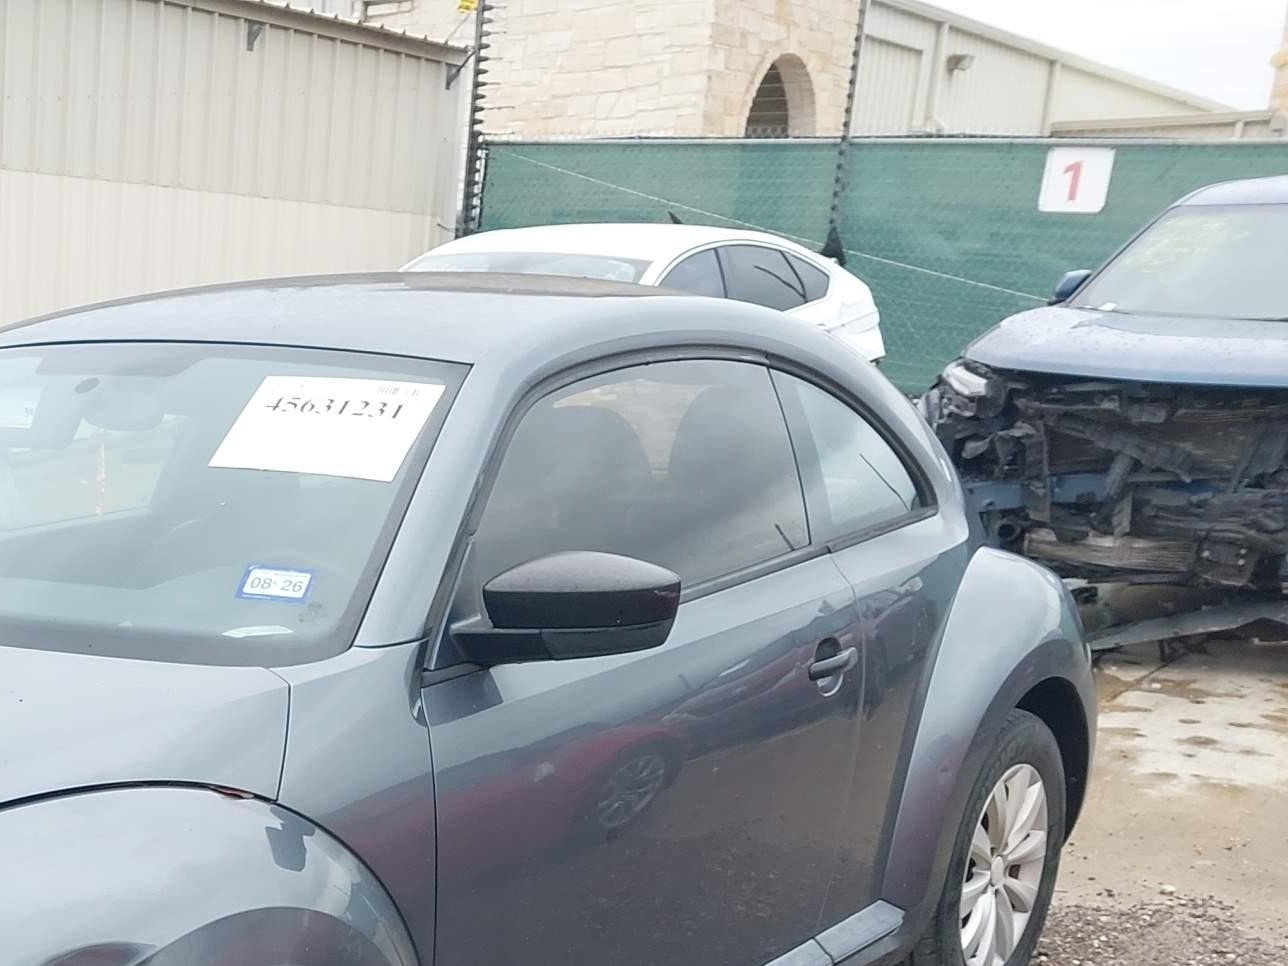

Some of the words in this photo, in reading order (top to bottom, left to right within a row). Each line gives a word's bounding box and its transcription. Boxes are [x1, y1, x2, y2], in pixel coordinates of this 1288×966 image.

[1063, 160, 1085, 201] 1
[250, 576, 273, 590] 08
[279, 579, 305, 593] 26
